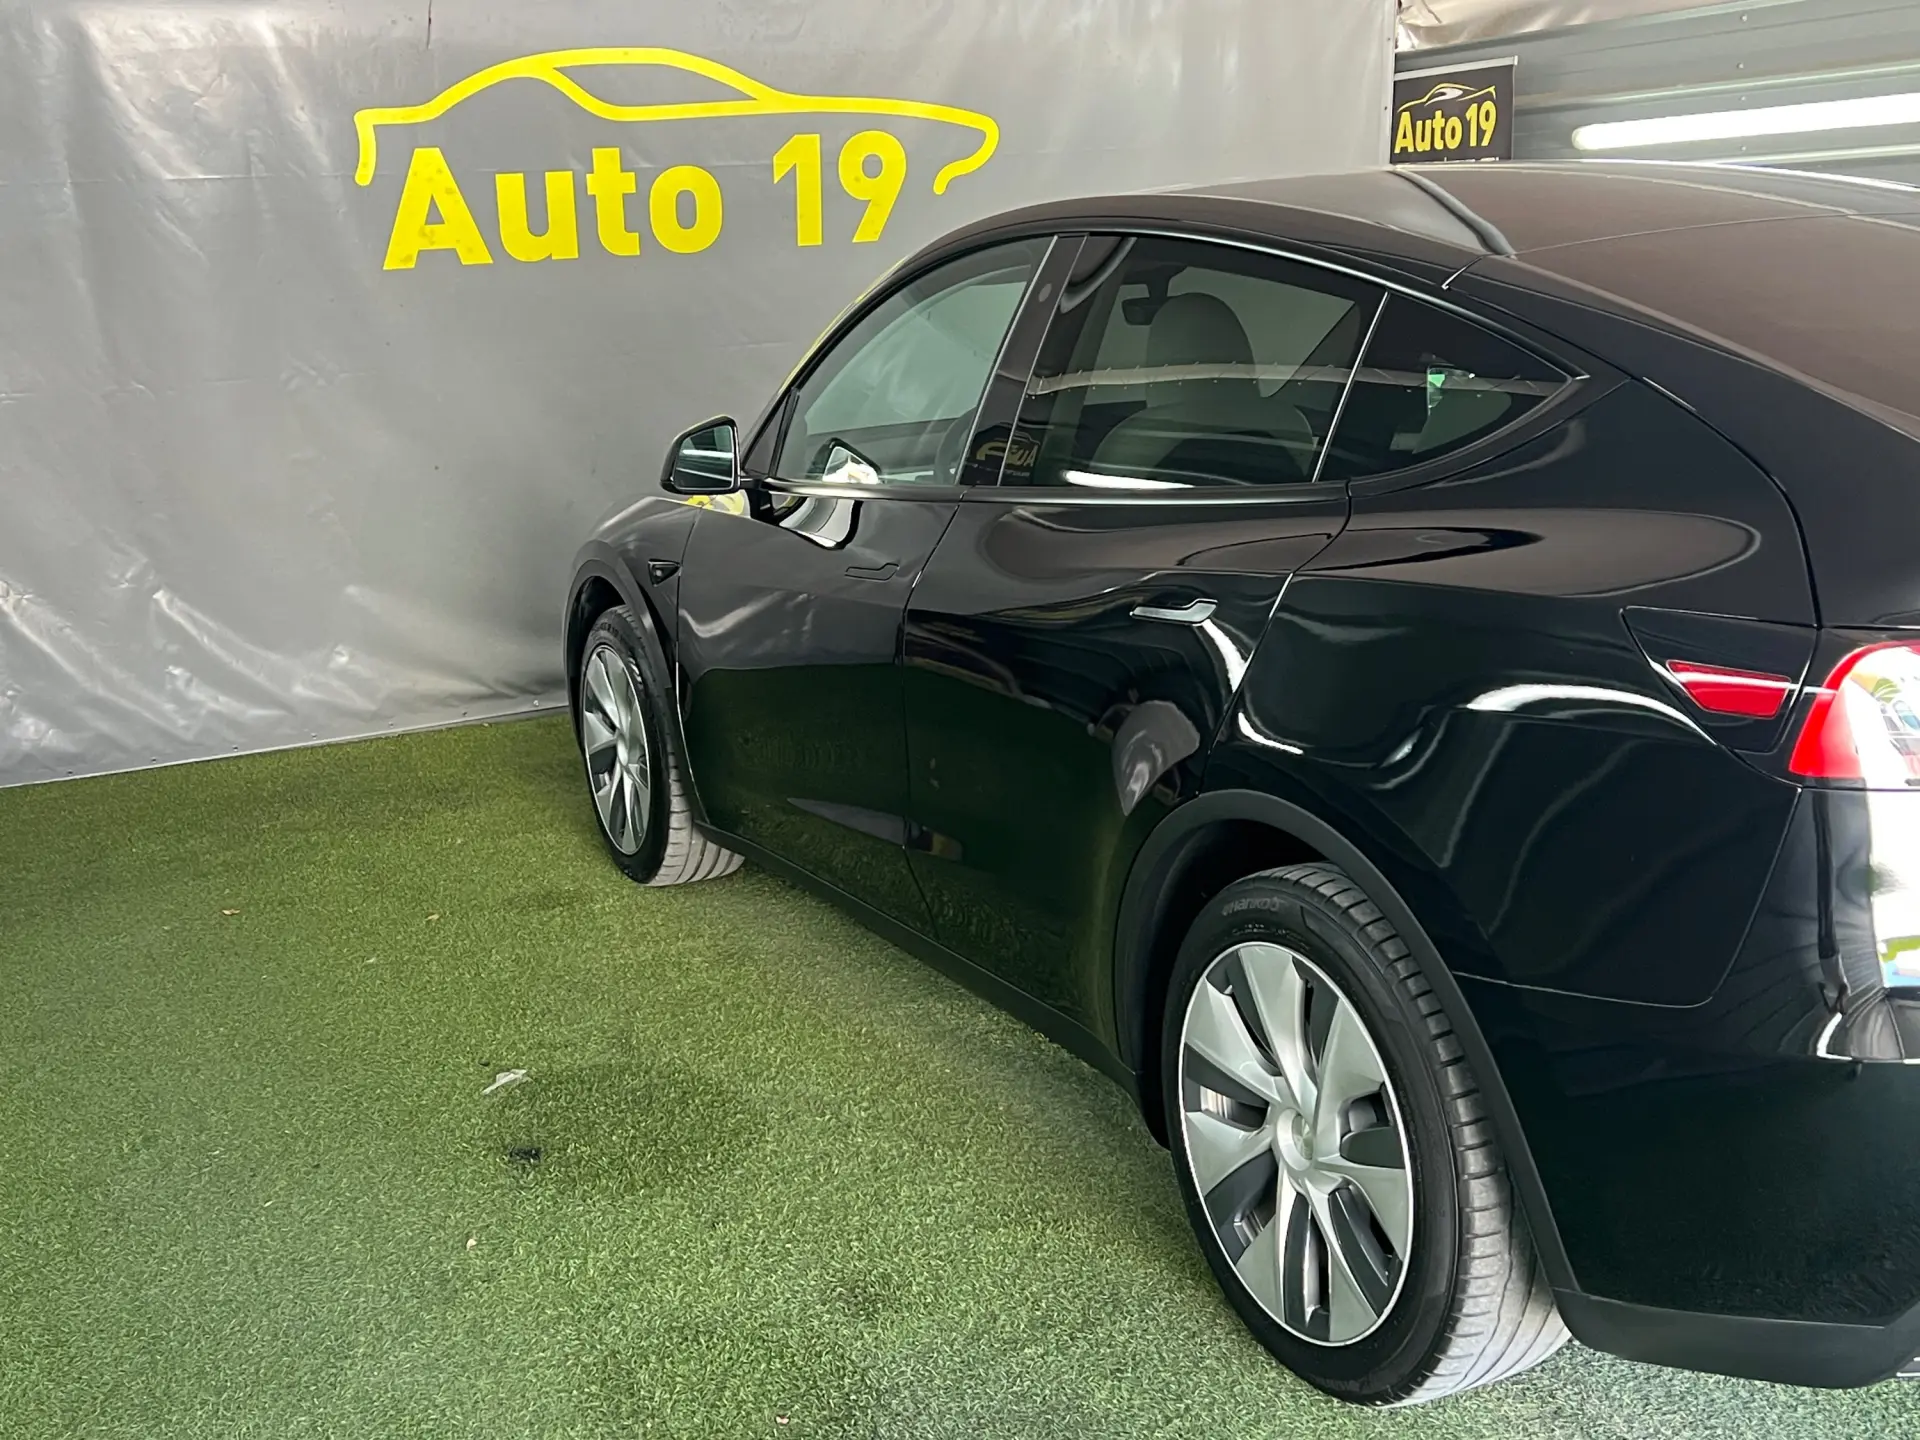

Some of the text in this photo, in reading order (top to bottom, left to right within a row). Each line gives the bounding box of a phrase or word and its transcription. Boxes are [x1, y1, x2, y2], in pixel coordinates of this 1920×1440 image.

[1394, 101, 1496, 153] Auto 19
[383, 130, 907, 270] Auto 19
